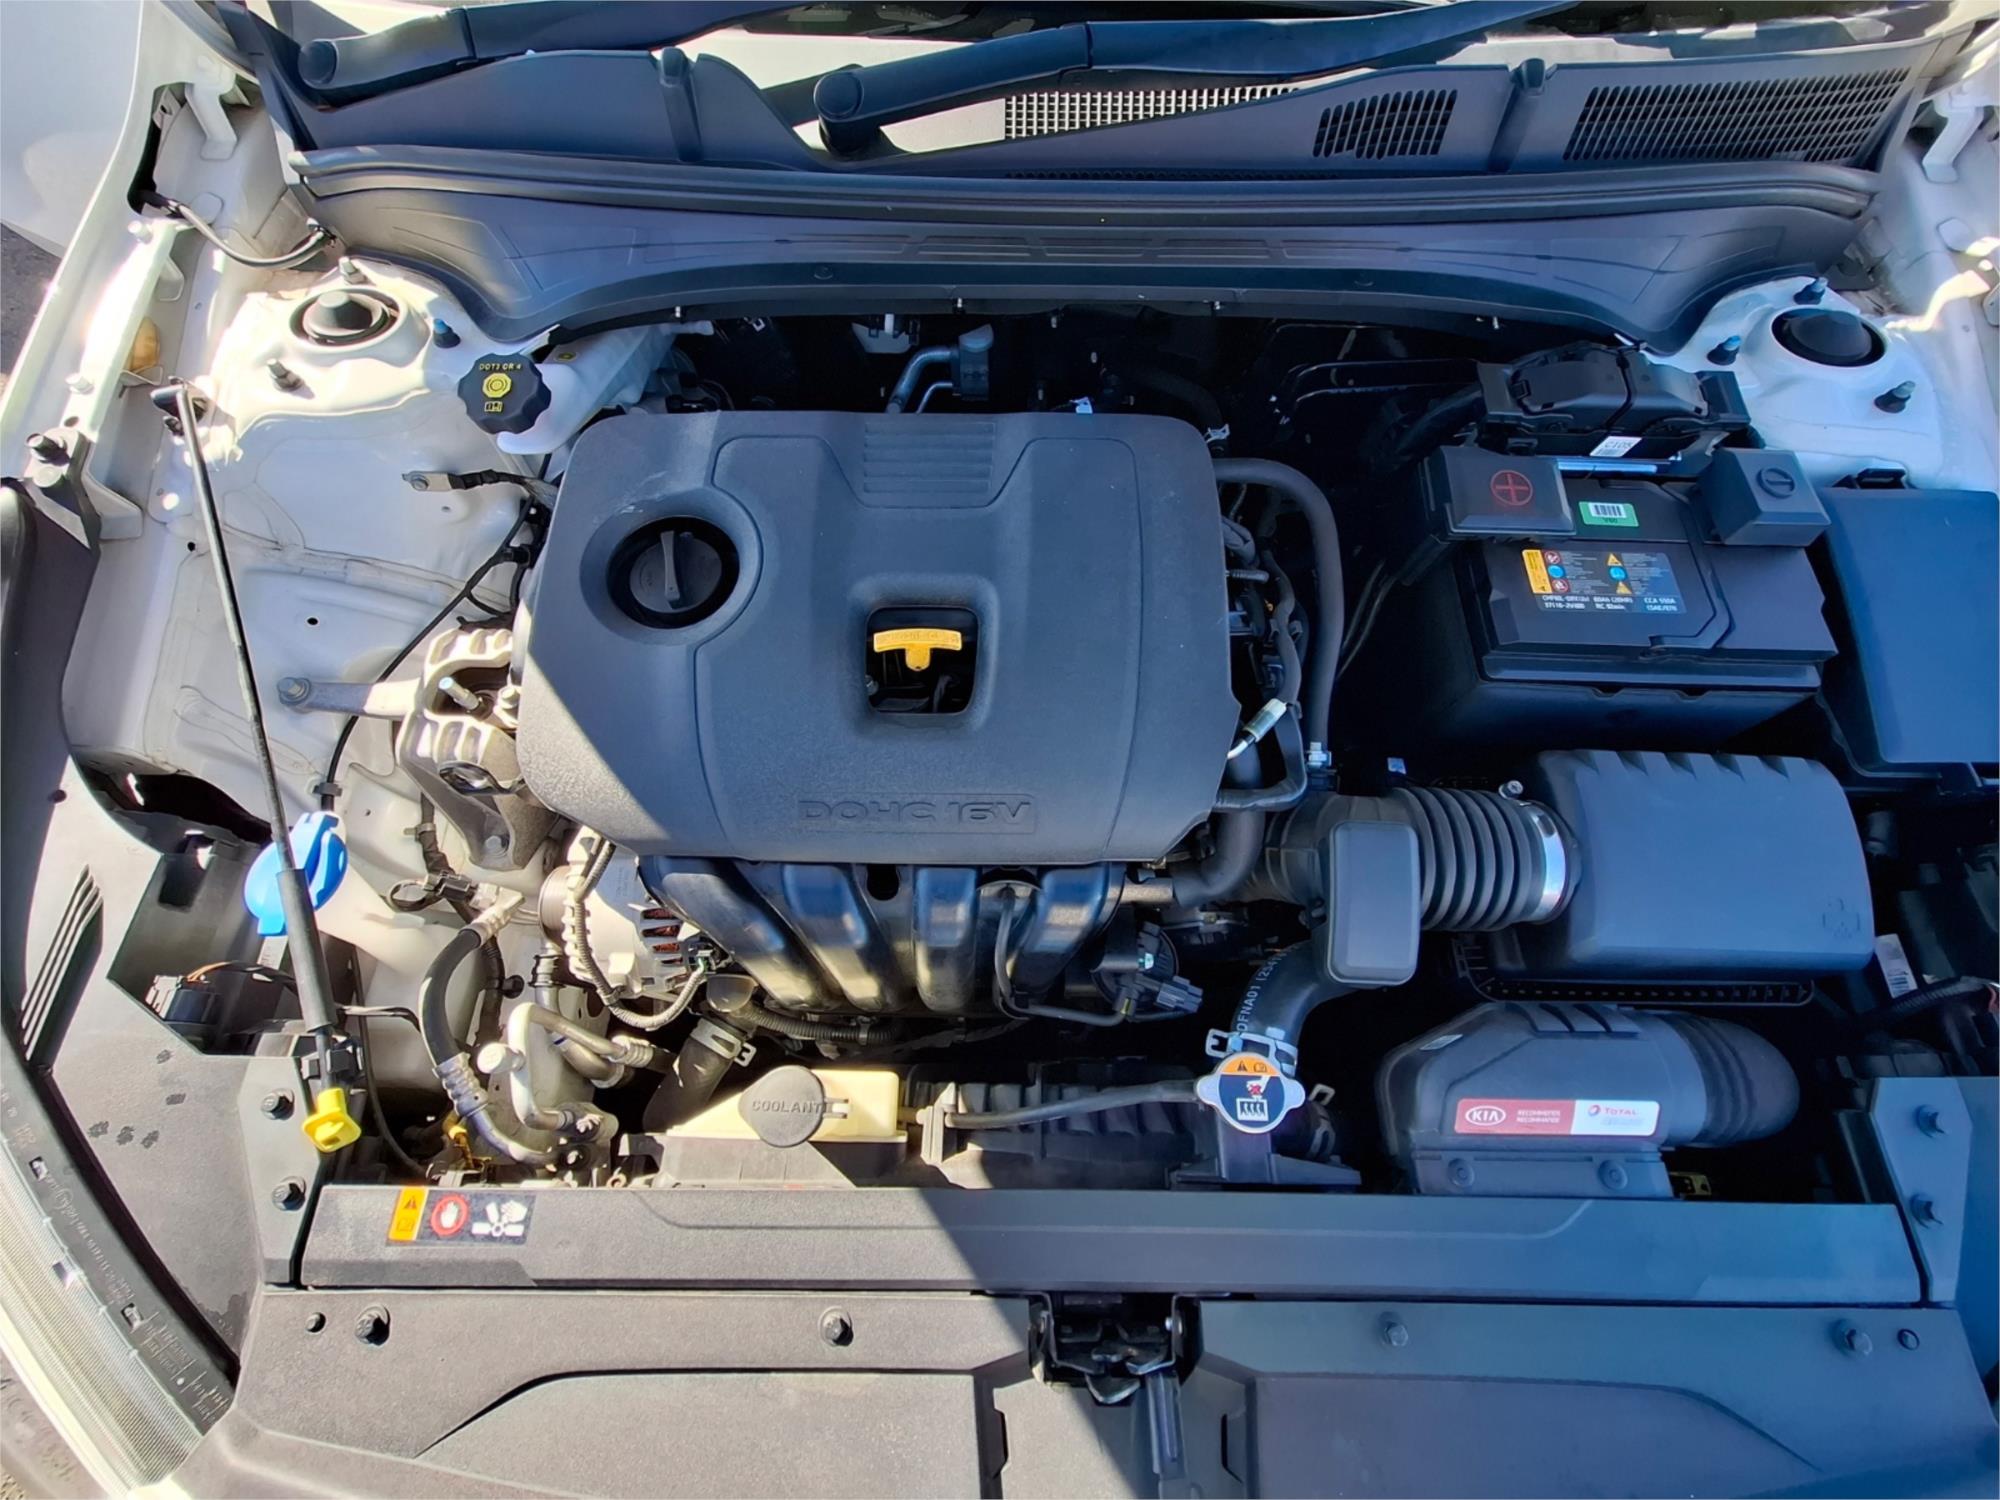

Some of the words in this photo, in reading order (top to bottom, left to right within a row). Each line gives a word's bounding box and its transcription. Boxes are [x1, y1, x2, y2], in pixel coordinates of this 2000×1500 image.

[797, 800, 937, 823] DOHC
[948, 801, 1032, 825] 16V
[752, 1100, 822, 1114] COOLANT
[1471, 1110, 1499, 1122] KIA
